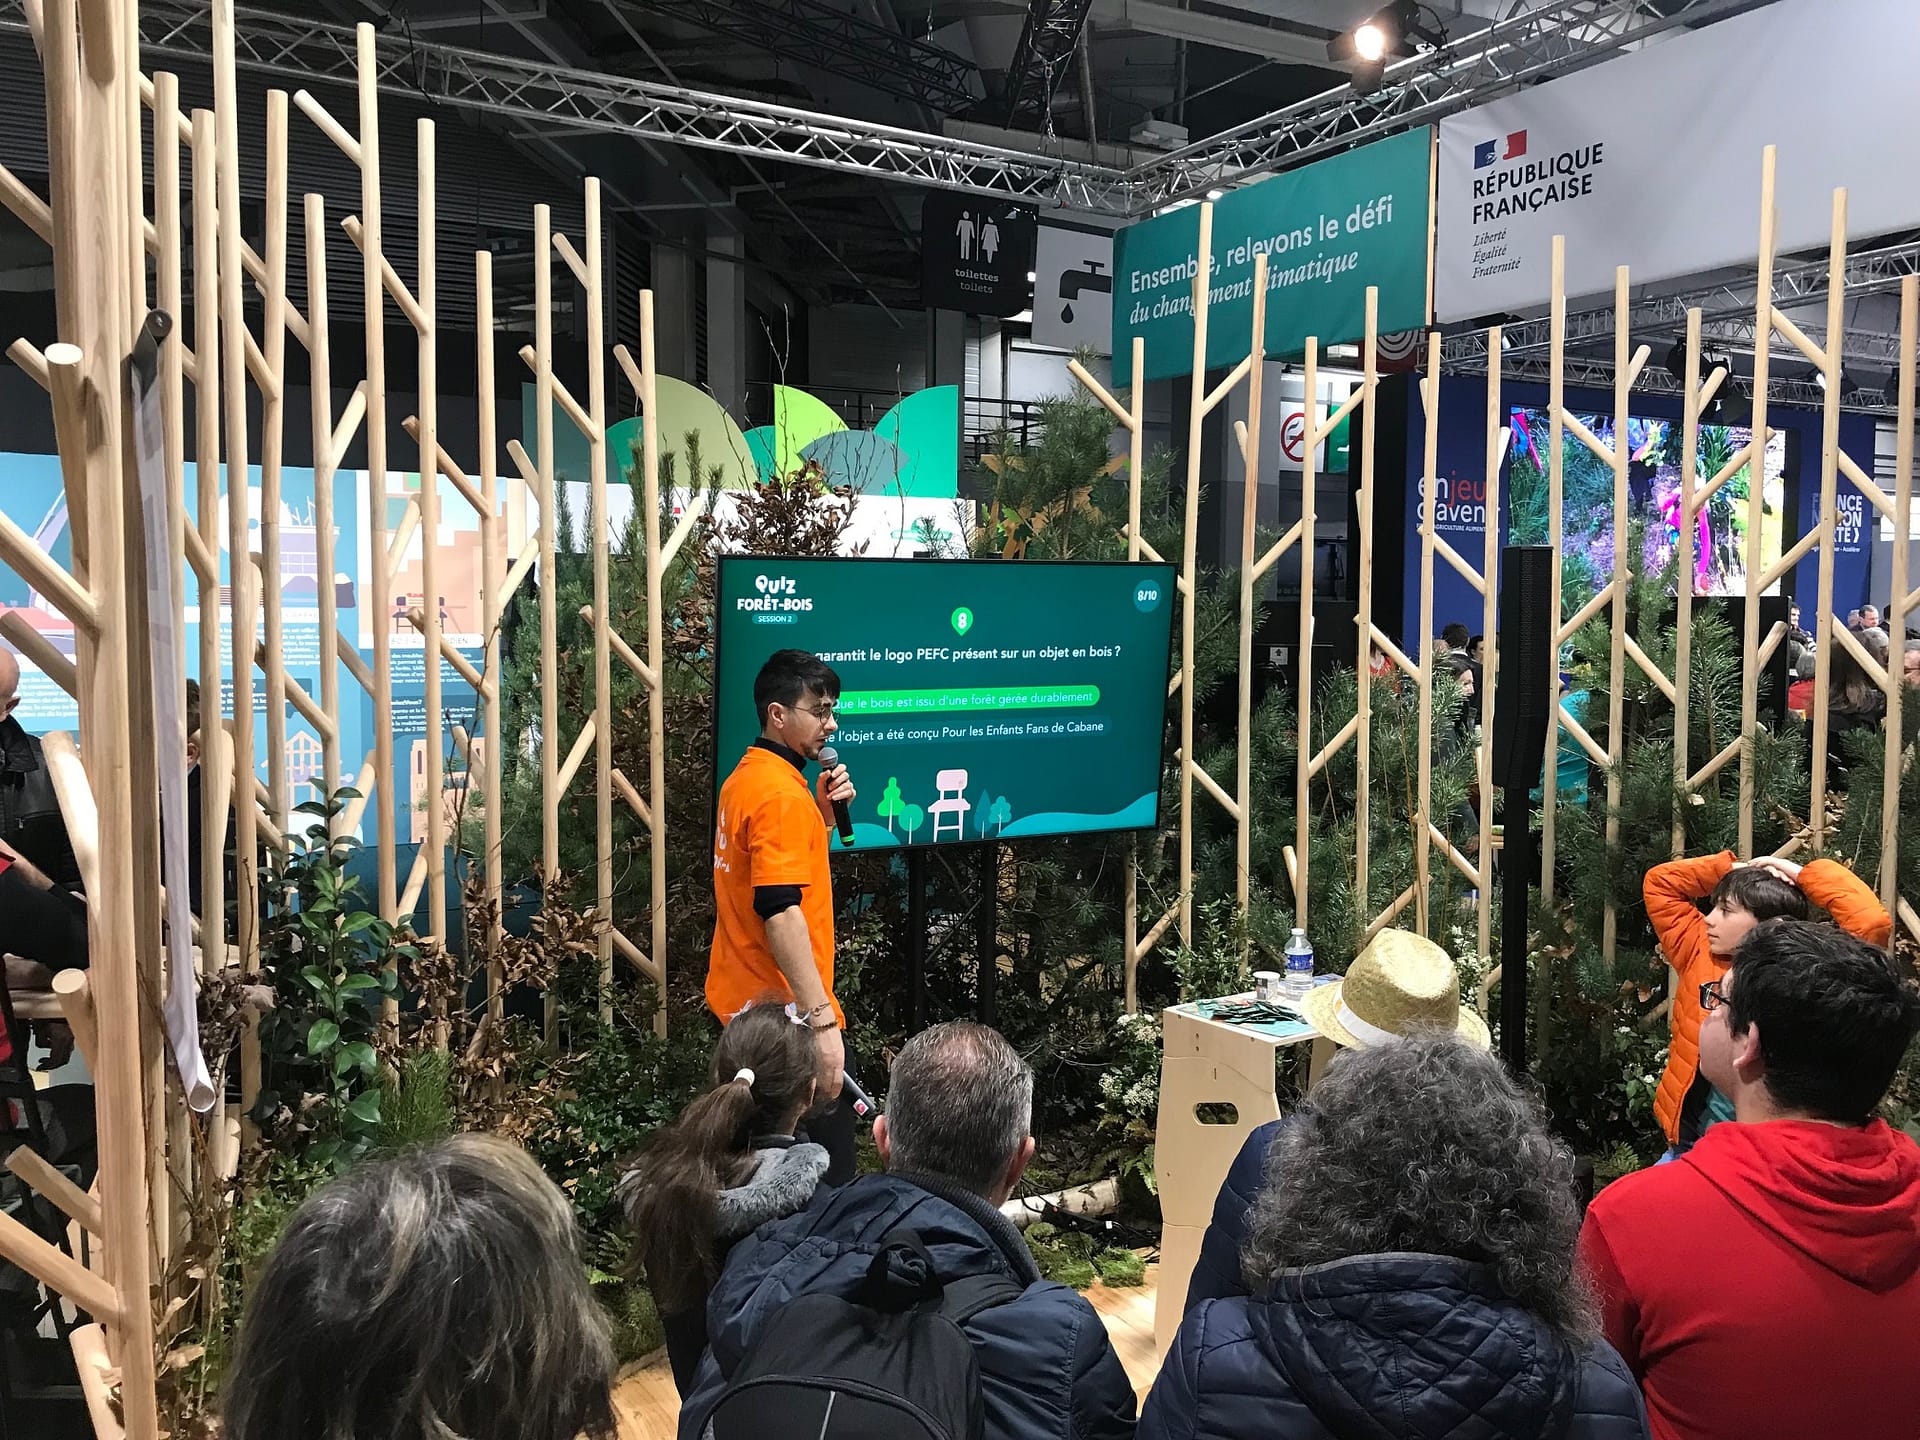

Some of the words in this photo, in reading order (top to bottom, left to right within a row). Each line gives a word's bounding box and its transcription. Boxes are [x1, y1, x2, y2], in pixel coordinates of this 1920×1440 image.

[1473, 142, 1603, 199] RÉPUBLIQUE
[1473, 173, 1592, 225] FRANÇAISE
[1131, 253, 1220, 294] Ensemb,
[1226, 225, 1312, 267] relevons
[1319, 215, 1339, 241] le
[1346, 194, 1393, 233] défi
[1473, 227, 1507, 247] Liberté
[1472, 243, 1507, 264] Égalité
[955, 268, 999, 282] toilettes
[1472, 257, 1521, 279] Fraternité
[960, 282, 993, 294] toilets
[1129, 304, 1149, 325] du
[1152, 277, 1252, 319] chanment
[1265, 251, 1359, 291] limatique
[1812, 493, 1862, 511] FNCE
[1434, 524, 1465, 532] GRICULTURE
[737, 594, 813, 611] FORÊT-BOIS
[1137, 589, 1158, 602] 8/10
[758, 615, 787, 623] SESSION
[787, 615, 793, 623] 2
[957, 612, 968, 629] 8
[869, 648, 882, 660] le
[885, 648, 913, 664] logo
[916, 648, 950, 660] PEFC
[952, 647, 998, 662] présent
[1000, 649, 1019, 659] sur
[1022, 649, 1036, 659] un
[1039, 646, 1069, 661] objet
[1072, 648, 1086, 658] en
[1089, 645, 1112, 657] bois
[857, 698, 867, 708] le
[870, 697, 893, 708] bois
[896, 698, 912, 708] est
[915, 697, 935, 707] issu
[938, 695, 968, 707] d'une
[971, 693, 995, 705] forêt
[1030, 691, 1093, 703] durablement
[838, 730, 873, 744] l'objet
[876, 732, 884, 741] a
[886, 729, 905, 740] été
[907, 729, 939, 741] conçu
[942, 727, 967, 738] Pour
[969, 725, 984, 736] les
[986, 723, 1024, 736] Enfants
[1026, 723, 1049, 734] Fans
[1051, 721, 1065, 733] de
[1066, 720, 1104, 733] Cabane
